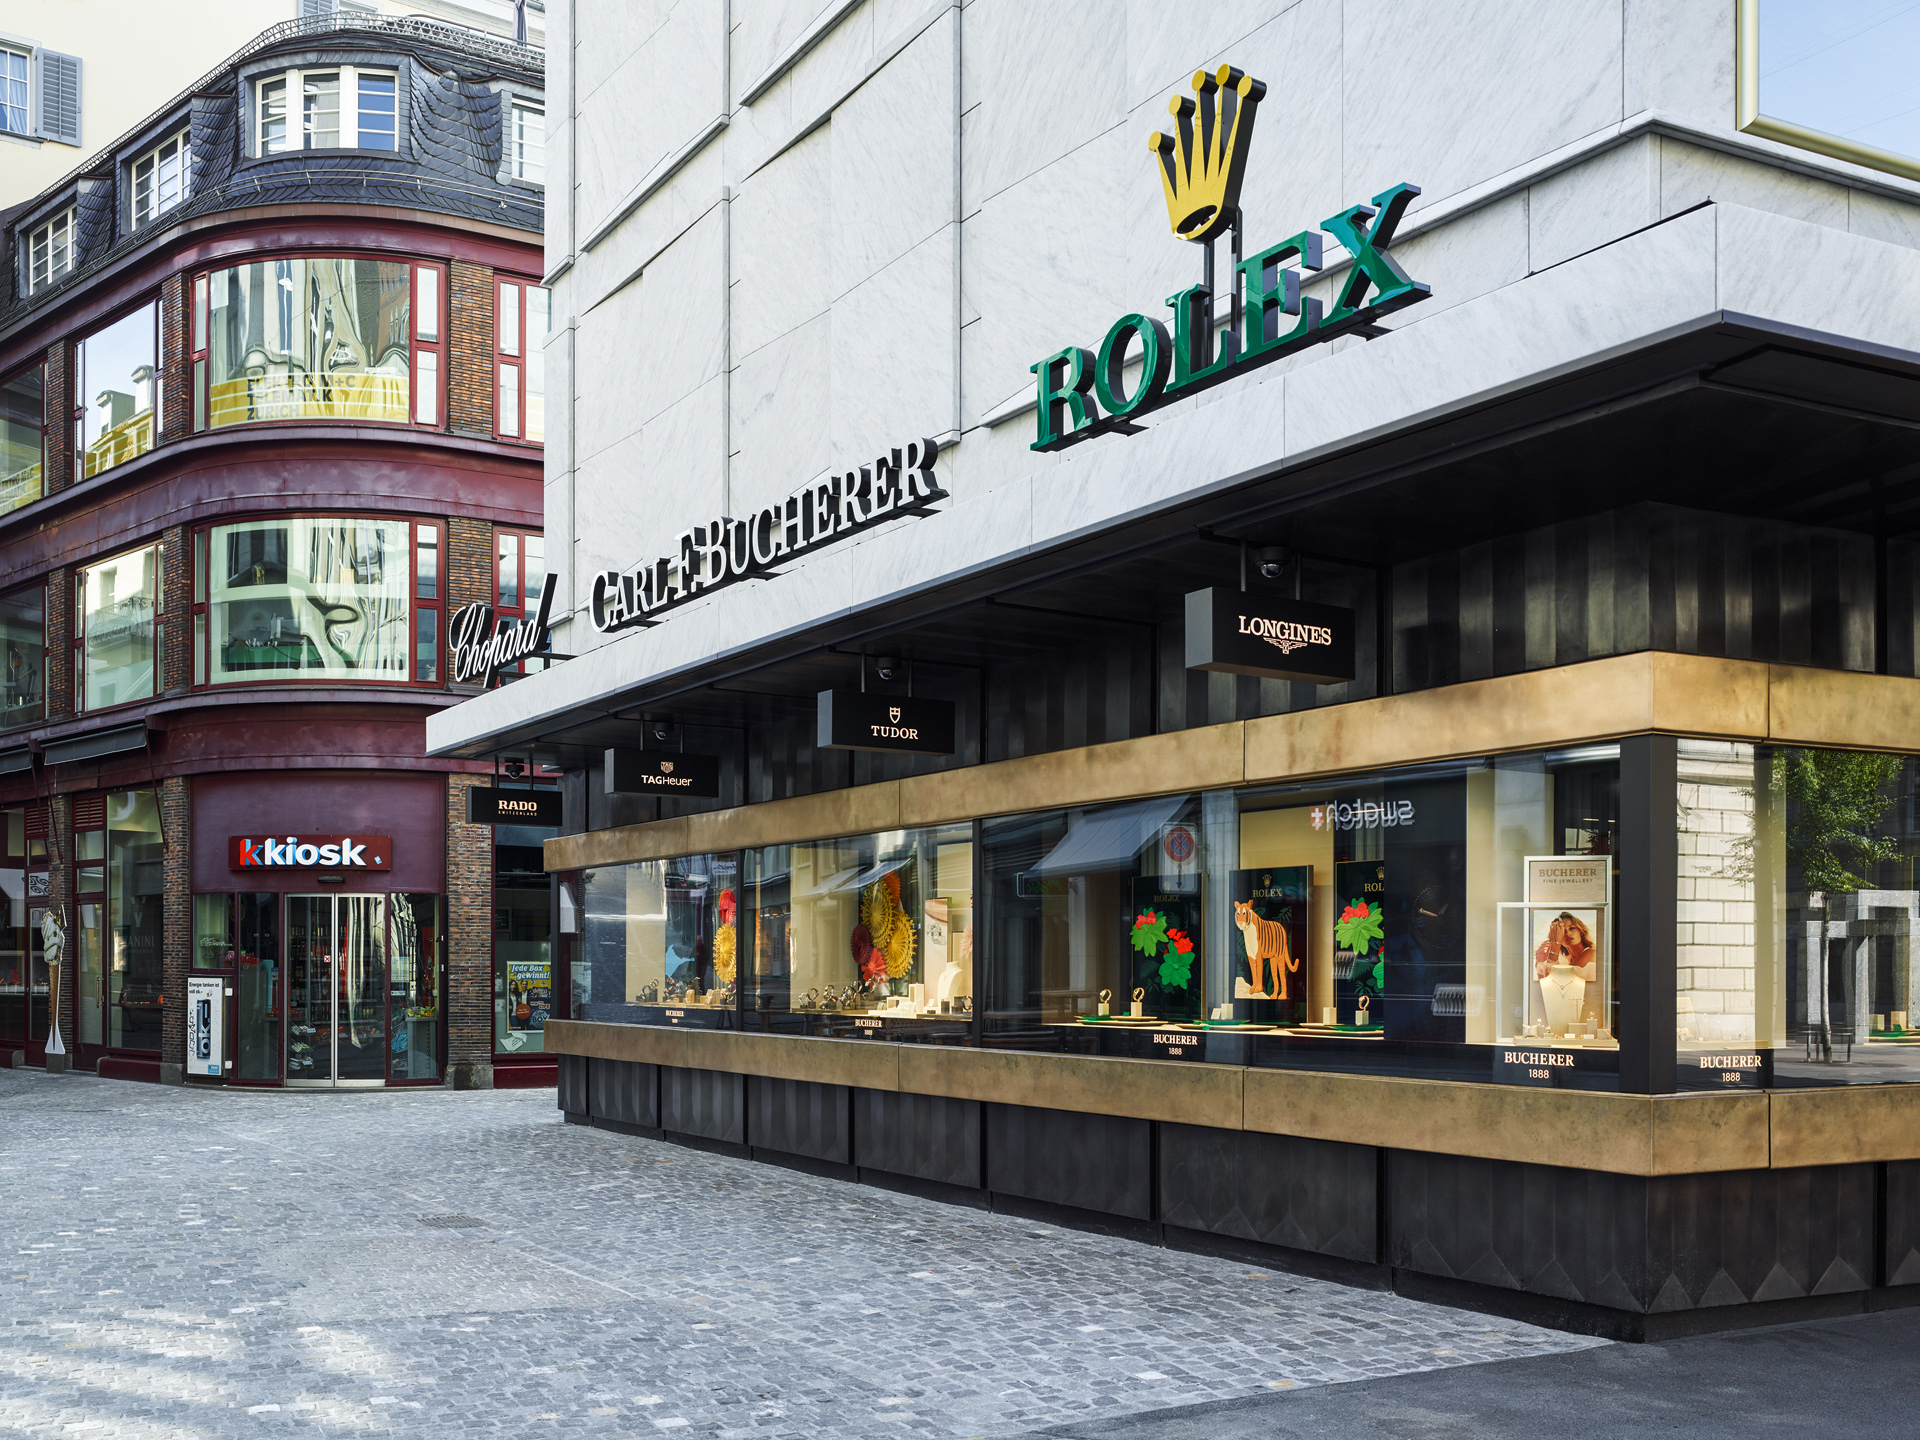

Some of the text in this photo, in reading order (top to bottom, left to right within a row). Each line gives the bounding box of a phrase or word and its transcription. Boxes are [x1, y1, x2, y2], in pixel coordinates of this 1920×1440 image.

[1030, 182, 1428, 451] ROLEX
[247, 373, 316, 392] ELEKTRO
[247, 387, 333, 406] TELEMATIK
[589, 556, 672, 633] CARL
[702, 437, 942, 586] BUCHERER
[449, 573, 555, 688] Chopard
[1238, 615, 1332, 645] LONGINES
[871, 725, 919, 740] TUDOR
[498, 800, 538, 811] RADO
[1538, 868, 1597, 877] BUCHERER
[1153, 894, 1180, 902] ROLEX
[1252, 888, 1283, 898] ROLEX
[511, 964, 544, 972] Jede Box
[516, 971, 550, 980] gewinnt!
[855, 1019, 882, 1028] BUCHERER
[1153, 1034, 1198, 1045] BUCHERER
[1169, 1047, 1183, 1056] 1888
[1504, 1051, 1575, 1067] BUCHERER
[1700, 1055, 1762, 1069] BUCHERER
[1528, 1069, 1550, 1079] 1888
[1722, 1072, 1741, 1082] 1888
